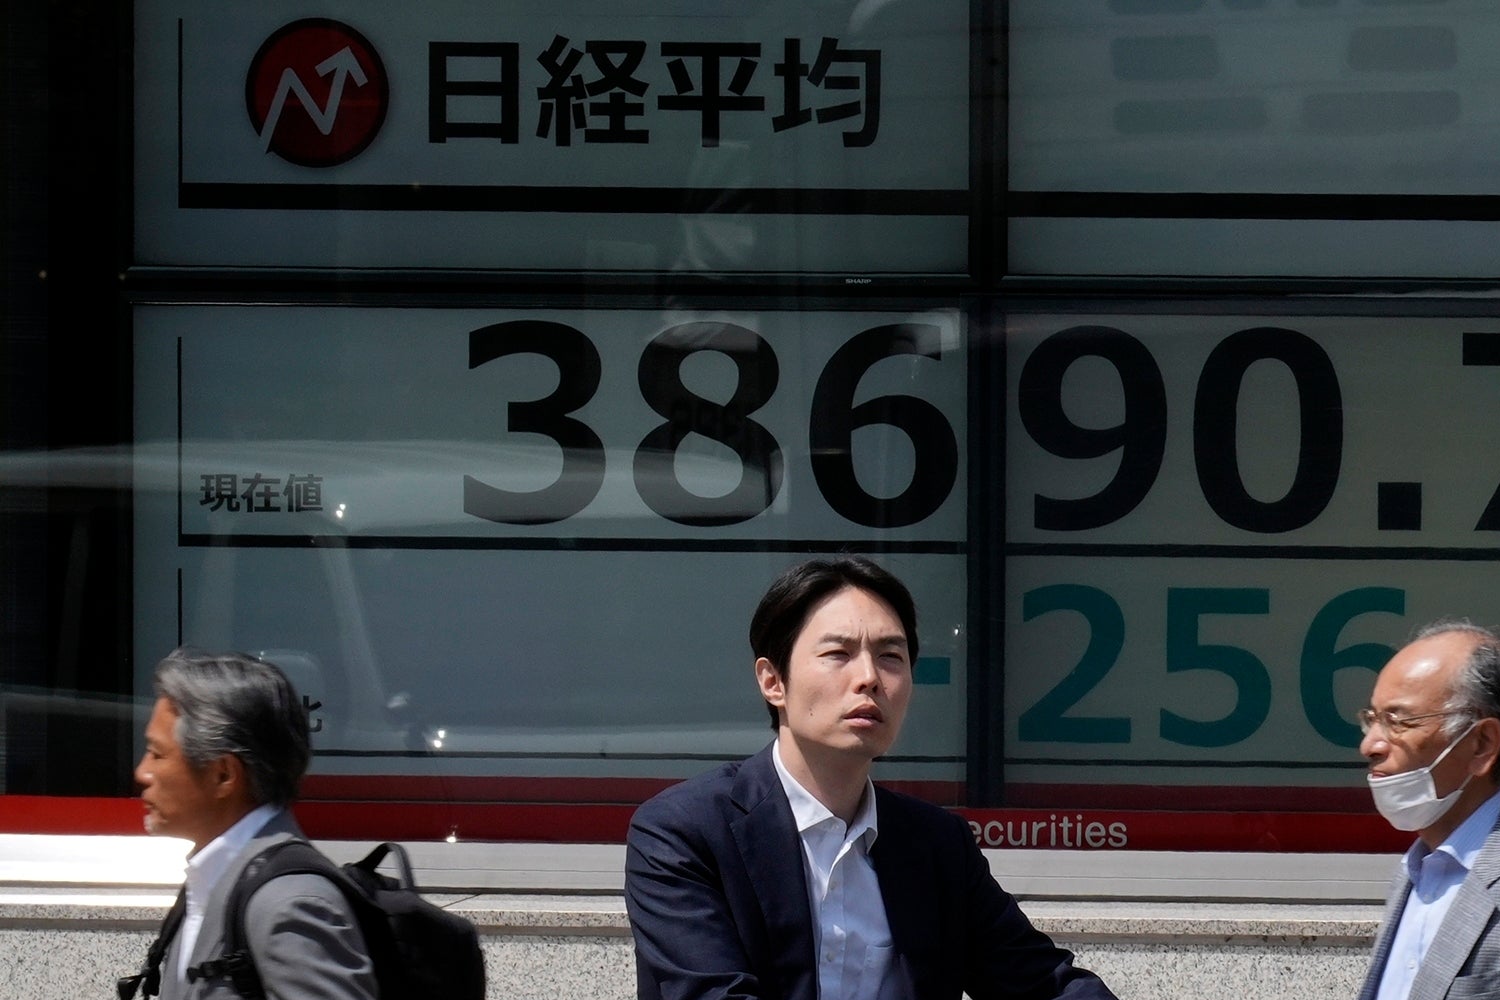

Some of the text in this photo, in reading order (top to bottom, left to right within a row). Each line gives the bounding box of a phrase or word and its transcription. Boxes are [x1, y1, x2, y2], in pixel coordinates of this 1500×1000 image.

[428, 34, 882, 148] 日経平均
[199, 473, 324, 513] 現在値
[966, 813, 1129, 848] ecurities
